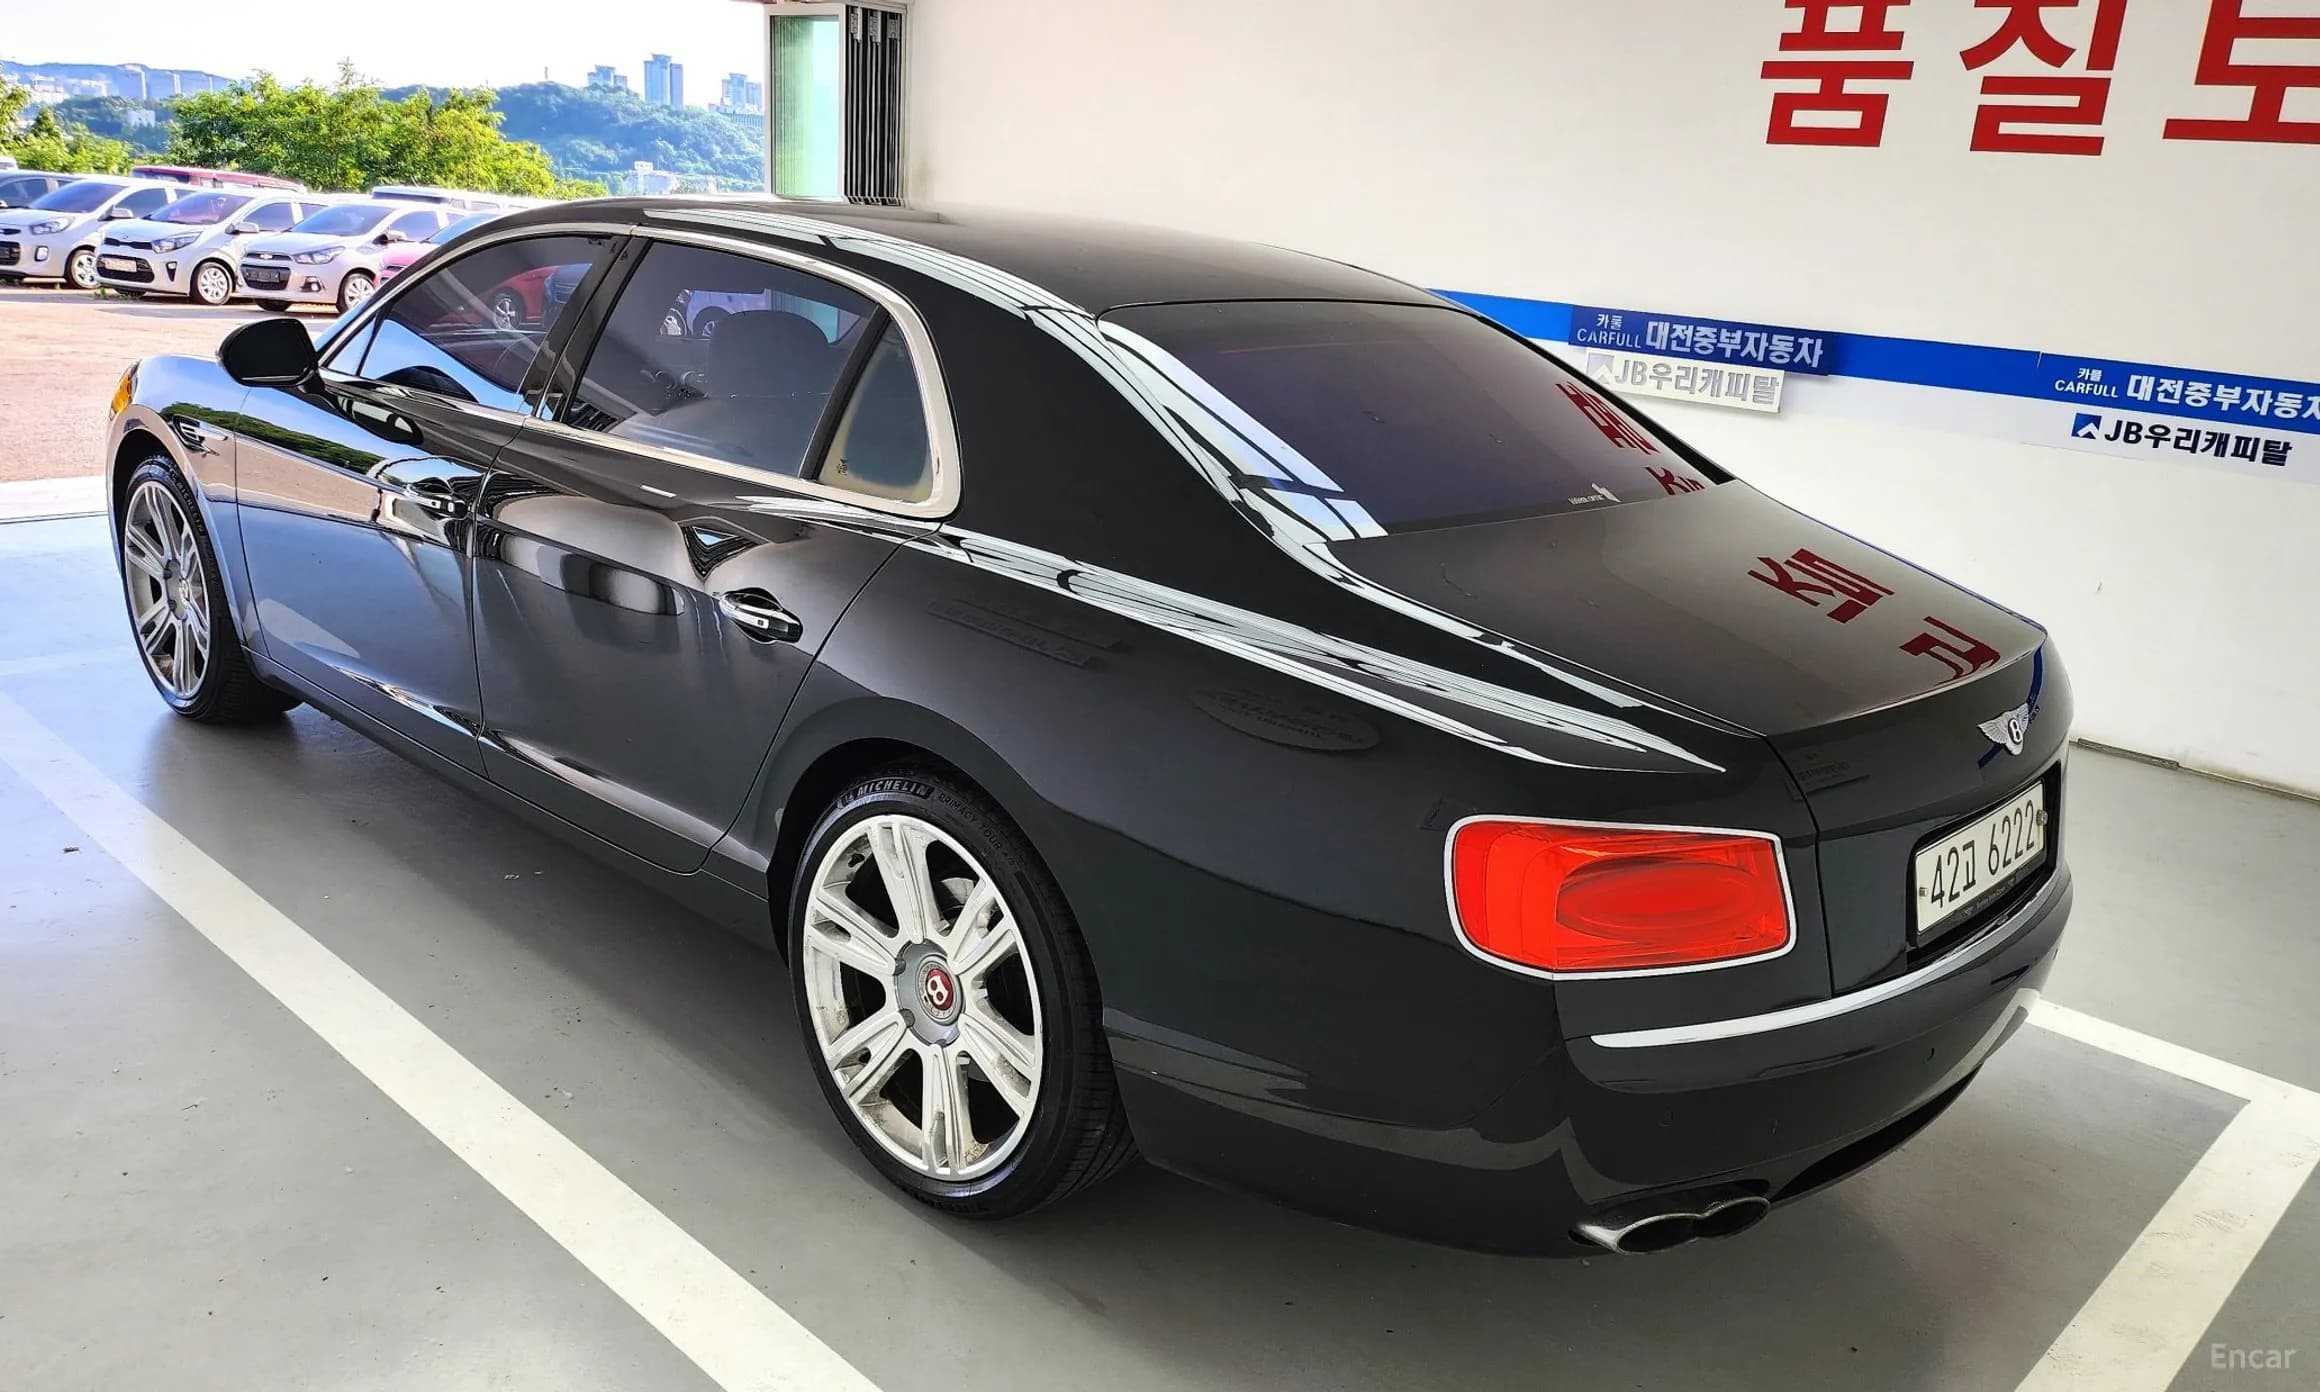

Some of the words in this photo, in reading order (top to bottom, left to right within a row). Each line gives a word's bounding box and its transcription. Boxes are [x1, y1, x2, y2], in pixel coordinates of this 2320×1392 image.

[1577, 328, 1642, 349] CARFULL
[1645, 320, 1824, 368] 대전중부자동차
[1615, 359, 1780, 405] JB우리캐피탈
[2054, 379, 2119, 398] CARFULL
[2104, 419, 2292, 467] JB우리캐피탈
[857, 780, 930, 797] MICHELIN
[1988, 799, 2034, 876] 6222
